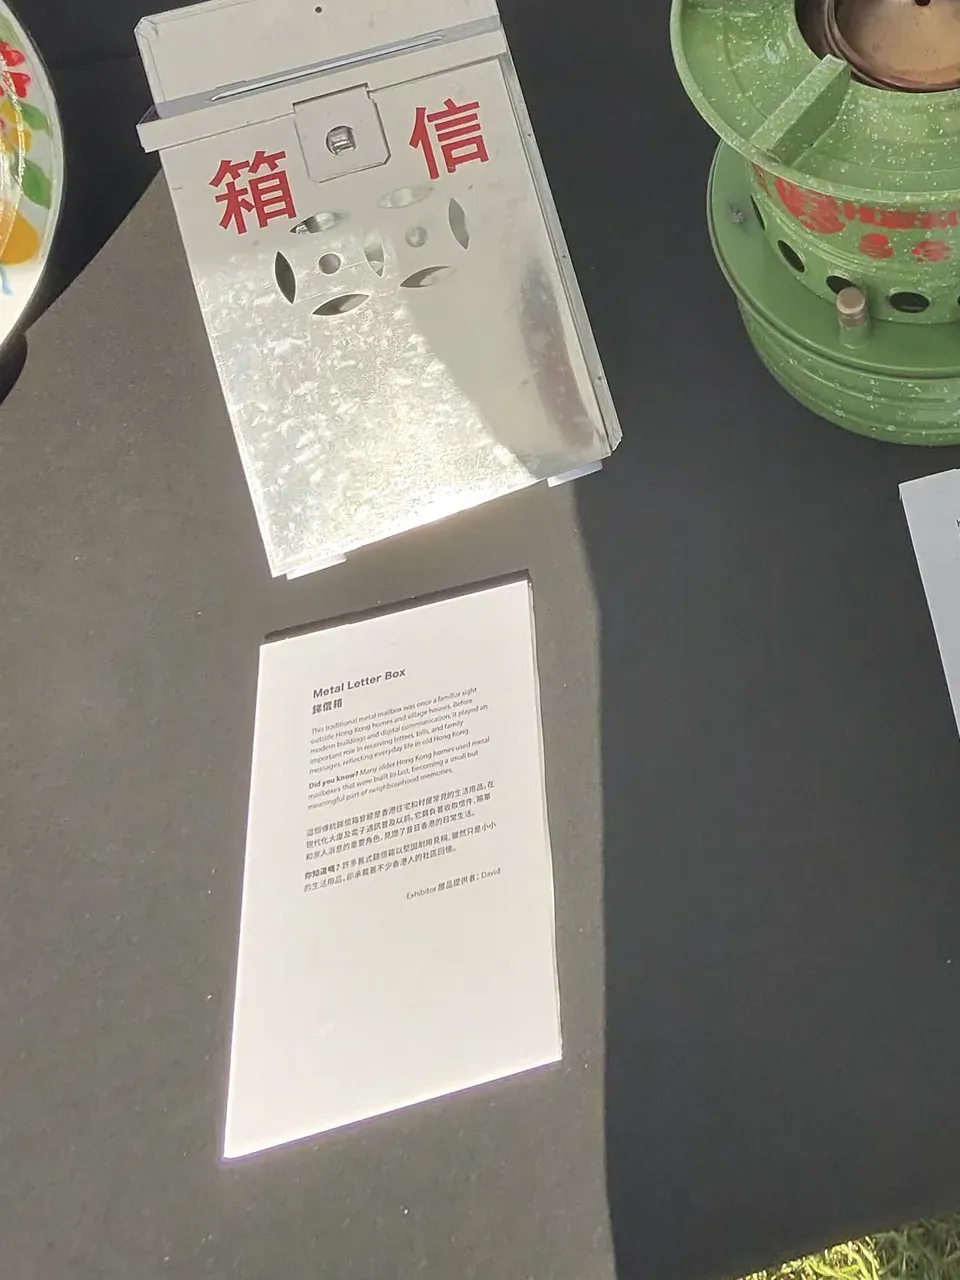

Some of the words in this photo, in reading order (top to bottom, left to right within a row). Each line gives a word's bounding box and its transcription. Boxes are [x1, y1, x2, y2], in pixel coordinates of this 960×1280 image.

[410, 99, 488, 179] 信
[210, 151, 296, 234] 箱
[313, 682, 344, 699] Metal
[347, 675, 382, 690] Letter
[385, 669, 406, 681] Box
